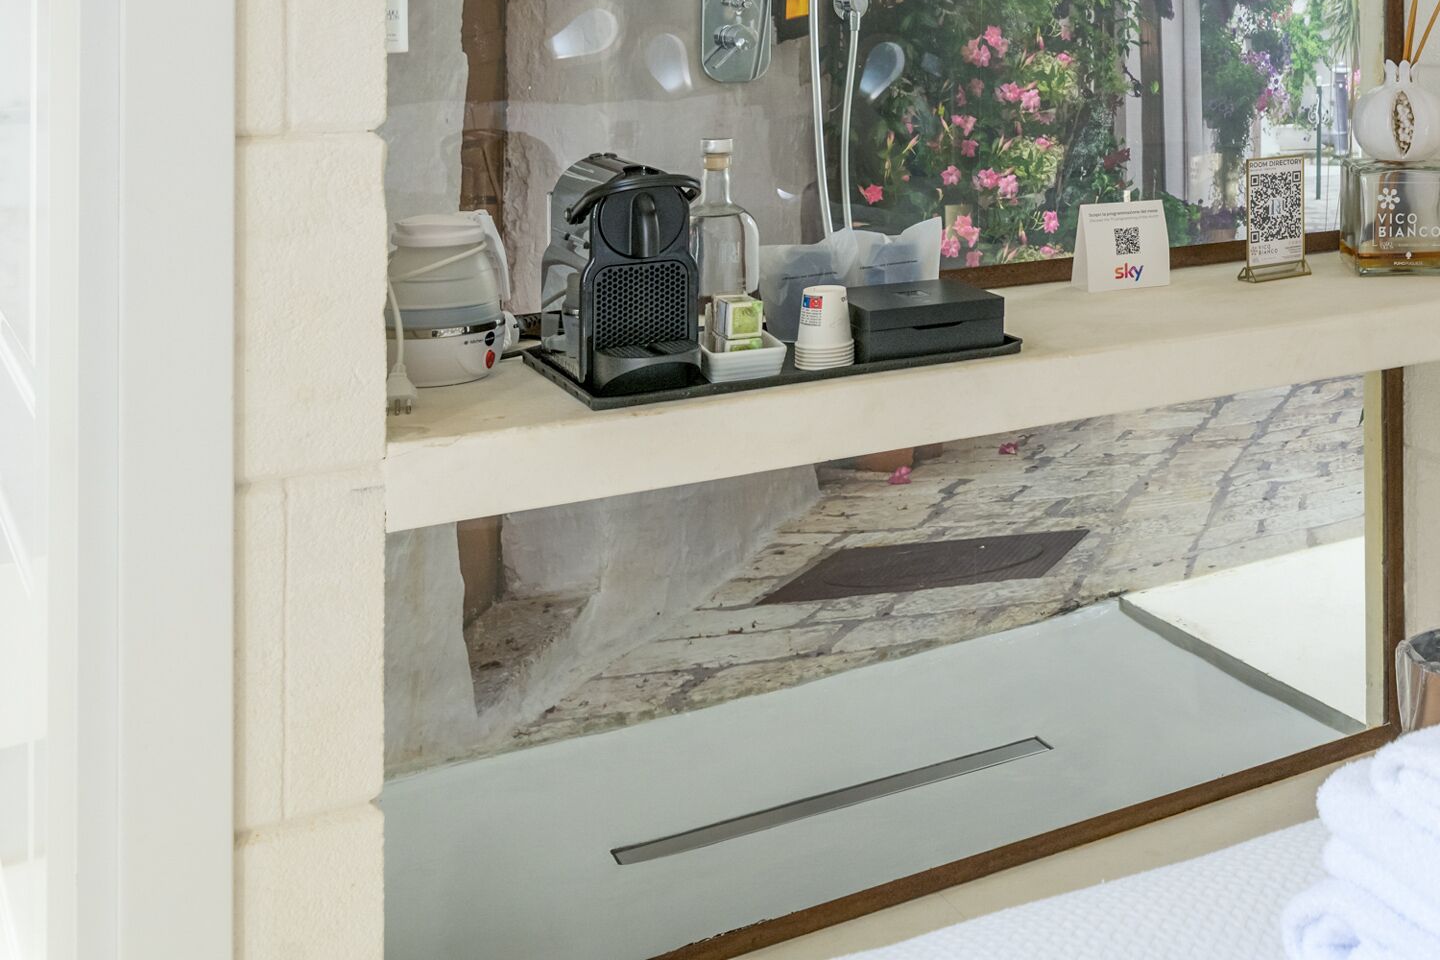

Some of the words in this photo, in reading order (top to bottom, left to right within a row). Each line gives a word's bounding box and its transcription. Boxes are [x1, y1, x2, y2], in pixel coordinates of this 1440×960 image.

[1269, 159, 1302, 167] DIRECTORY
[1378, 213, 1417, 224] VICO
[1378, 224, 1440, 237] BIANCO
[1115, 262, 1144, 281] sky
